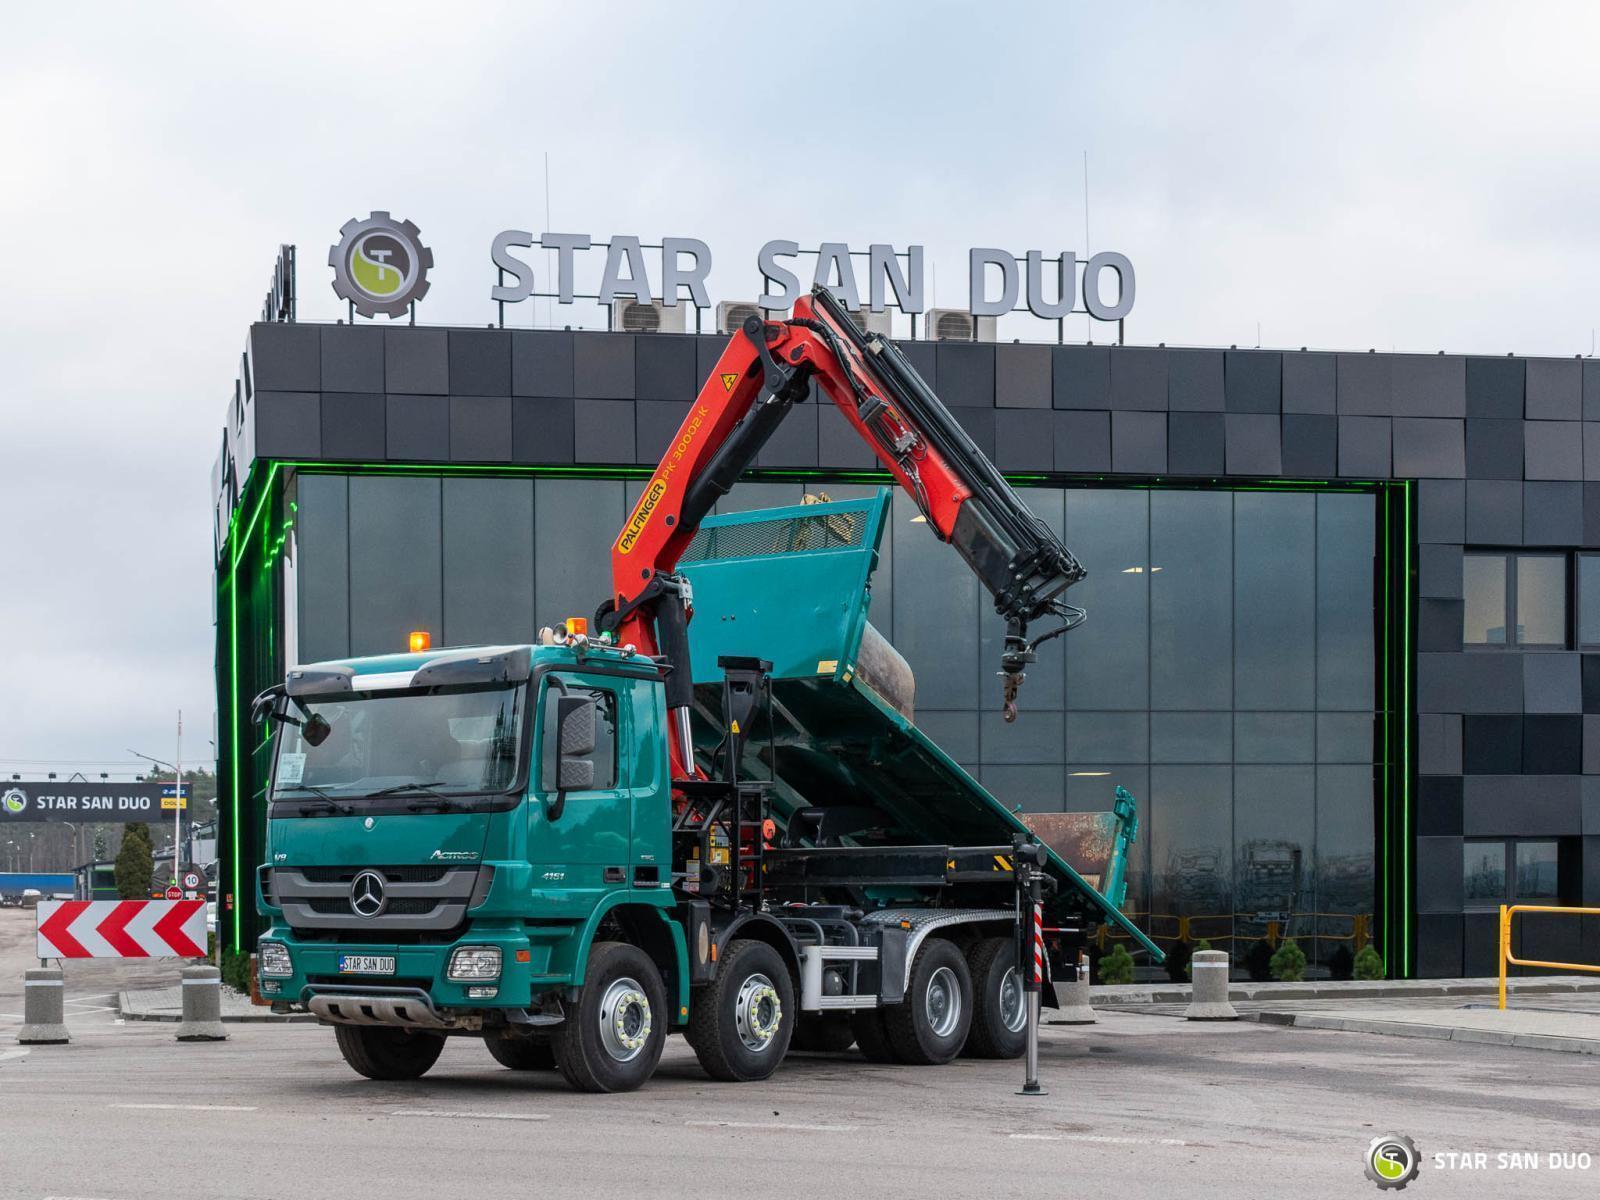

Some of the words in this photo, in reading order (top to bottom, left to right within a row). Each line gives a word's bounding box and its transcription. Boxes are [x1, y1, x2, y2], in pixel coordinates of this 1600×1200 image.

[490, 230, 712, 308] STAR
[757, 239, 924, 315] SAN
[969, 247, 1137, 321] DUO
[620, 482, 665, 550] PALFINGER
[662, 463, 677, 480] PK
[36, 796, 77, 810] STAR
[81, 796, 113, 810] SAN
[118, 796, 151, 810] DUO
[187, 876, 198, 885] 10
[344, 957, 362, 970] STAR
[363, 957, 378, 971] SAN
[379, 958, 394, 971] DUO
